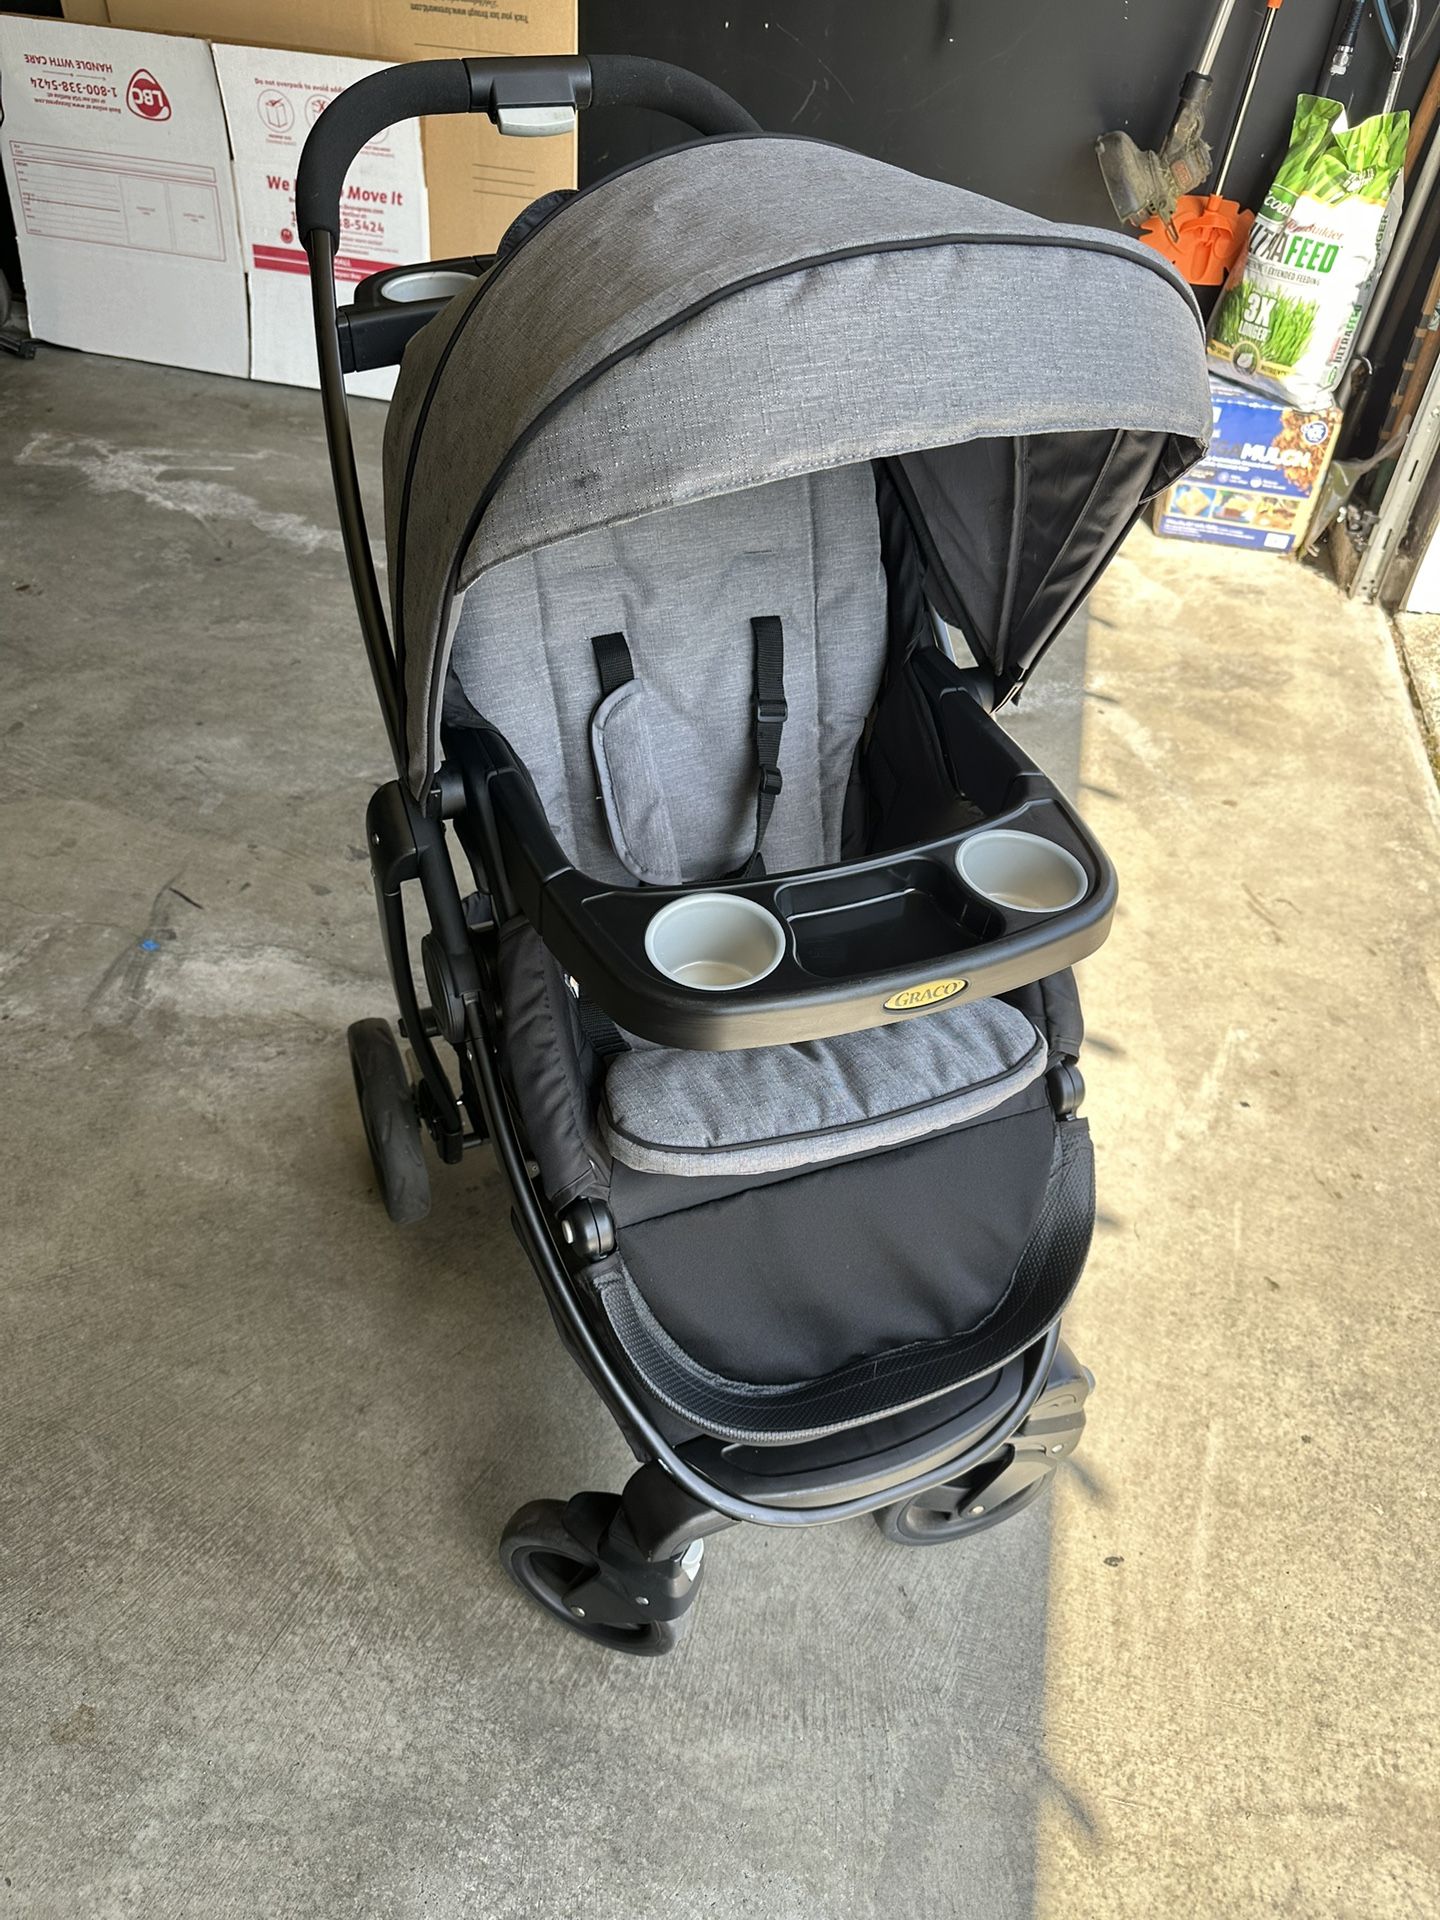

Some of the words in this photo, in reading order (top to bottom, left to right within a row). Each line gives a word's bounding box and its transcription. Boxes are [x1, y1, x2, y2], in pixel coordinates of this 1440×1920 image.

[23, 53, 47, 65] CARE
[48, 56, 75, 69] WITH
[75, 59, 113, 74] HANDLE
[30, 77, 118, 98] 1-800-338-5424
[254, 77, 264, 85] Do
[265, 78, 276, 86] not
[276, 79, 303, 90] overpack
[304, 82, 311, 90] to
[312, 82, 329, 92] avoid
[131, 87, 165, 107] LBC
[266, 175, 290, 192] We
[348, 185, 387, 203] Move
[391, 191, 404, 206] It
[1266, 266, 1296, 281] EXTENDED
[1244, 292, 1278, 328] 3X
[1238, 320, 1270, 341] LONGER
[1241, 442, 1313, 470] MULCH
[894, 982, 958, 1007] GRACO
